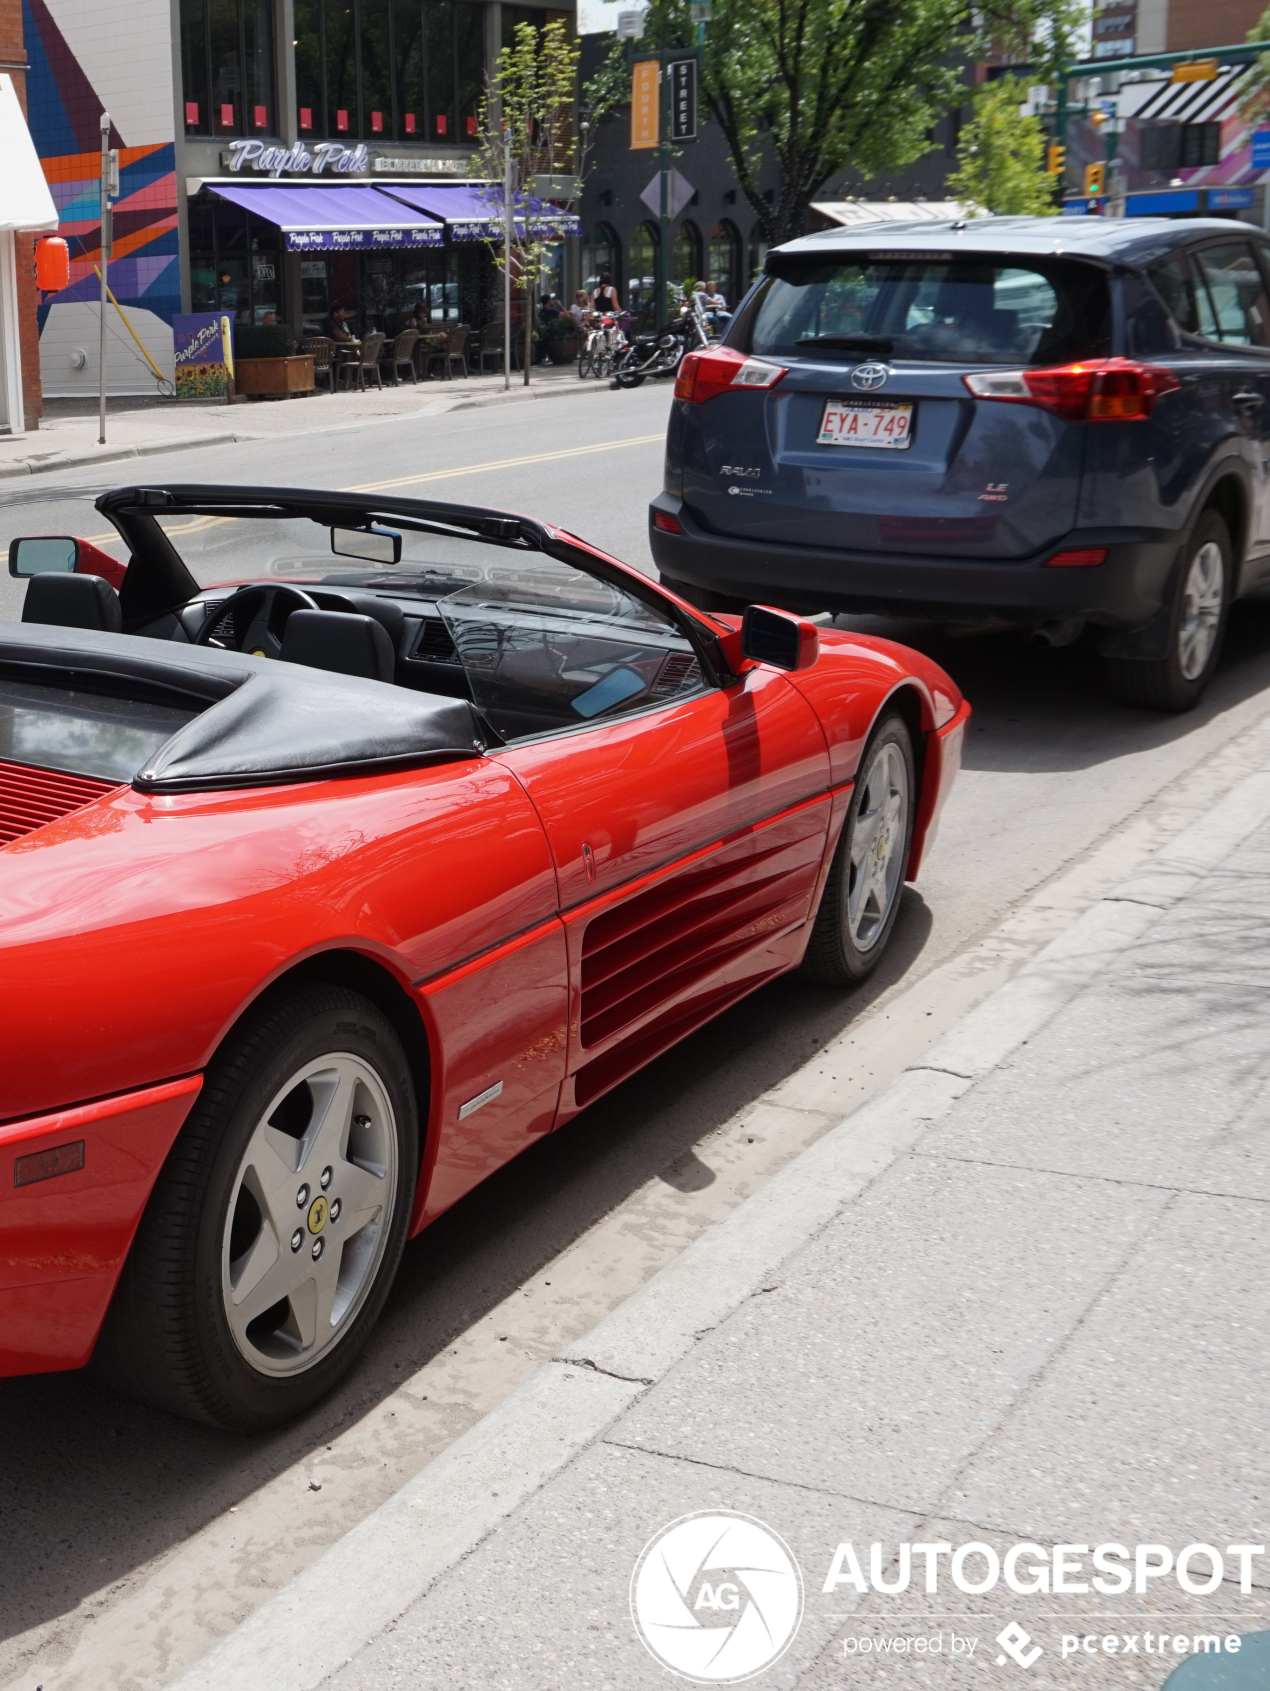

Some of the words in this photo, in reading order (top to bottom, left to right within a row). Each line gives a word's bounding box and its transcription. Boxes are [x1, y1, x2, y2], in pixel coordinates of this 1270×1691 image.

[641, 69, 650, 138] FOURTH
[679, 65, 688, 134] STREET
[229, 140, 312, 179] Purple
[311, 143, 368, 174] Perk
[290, 232, 309, 245] Purple
[309, 232, 323, 242] Perk
[332, 231, 350, 244] Purple
[350, 232, 363, 242] Perk
[372, 231, 390, 243] Purple
[390, 230, 403, 241] Perk
[412, 230, 428, 241] Purple
[428, 230, 441, 239] Perk
[174, 338, 200, 367] Purple
[197, 320, 218, 345] Perk
[823, 412, 908, 437] EYA-749
[720, 465, 761, 478] RAV4
[986, 483, 1009, 491] LE
